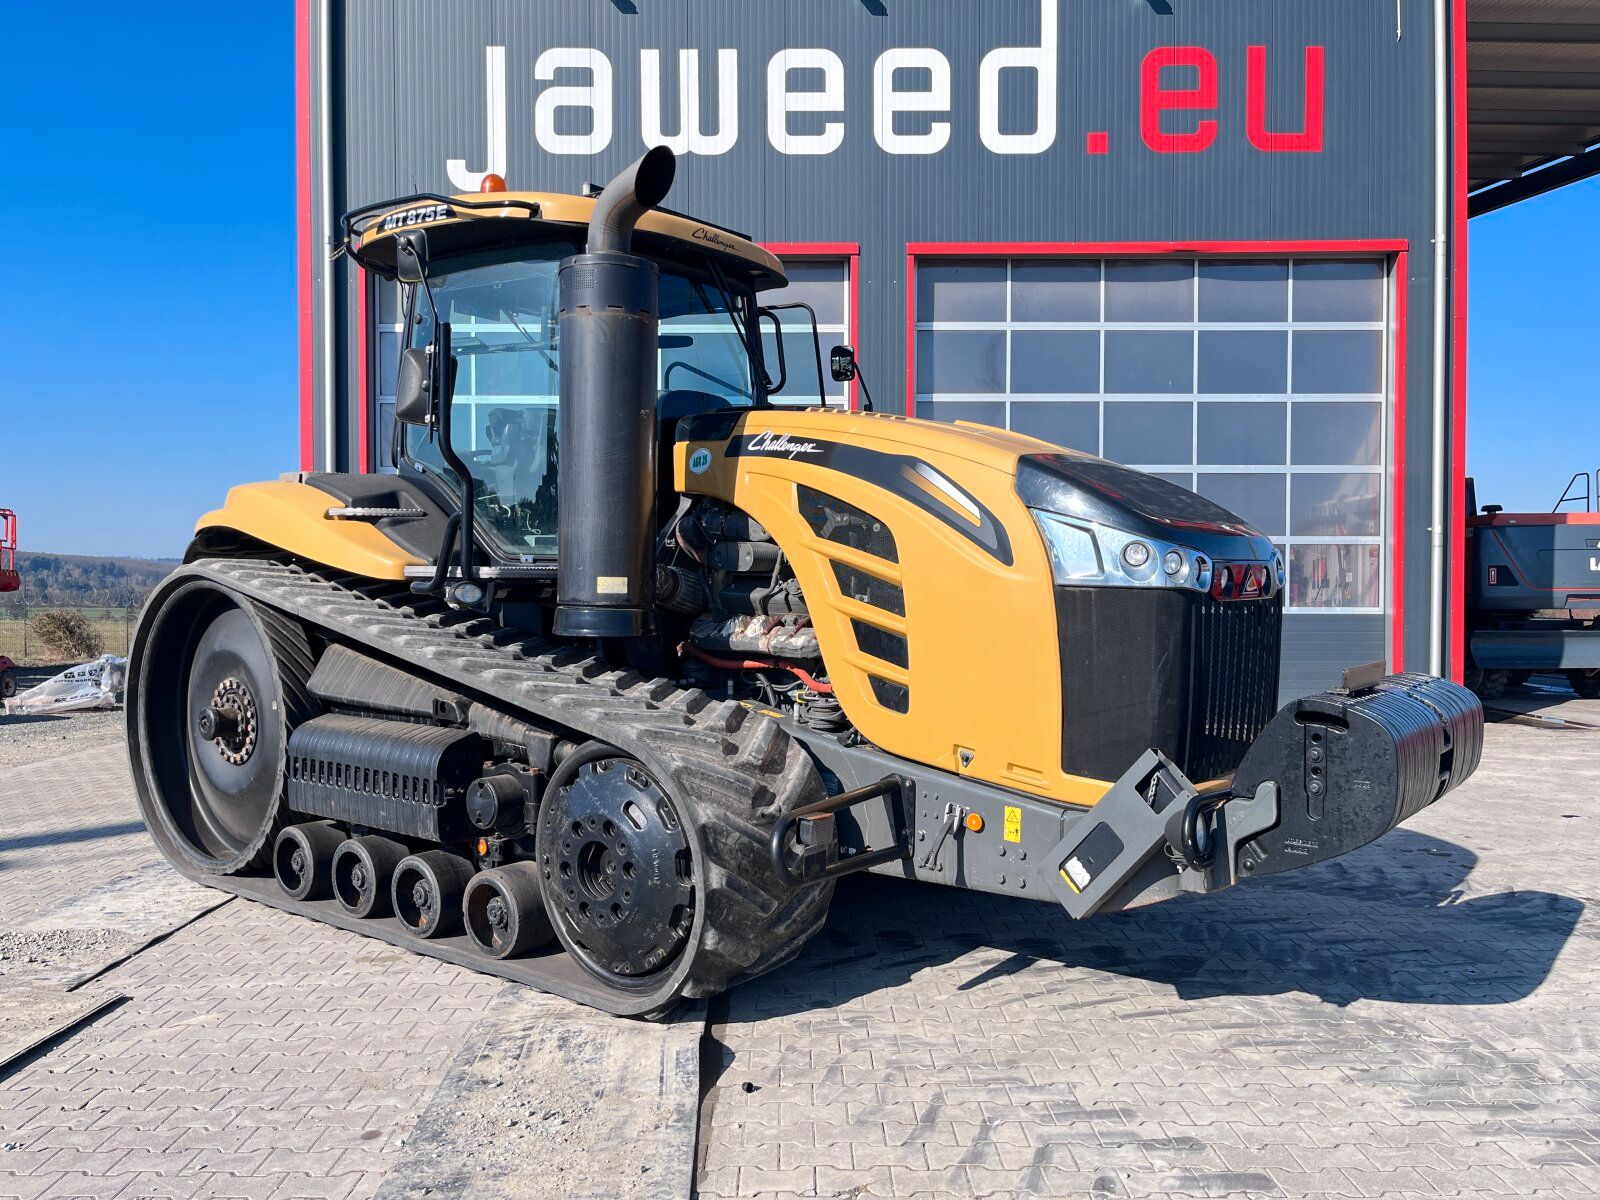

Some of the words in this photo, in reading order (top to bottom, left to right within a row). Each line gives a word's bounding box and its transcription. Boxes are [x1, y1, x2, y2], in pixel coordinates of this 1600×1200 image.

[446, 0, 1325, 192] jaweed.eu
[692, 227, 741, 252] Challenger
[747, 430, 825, 460] Challenger
